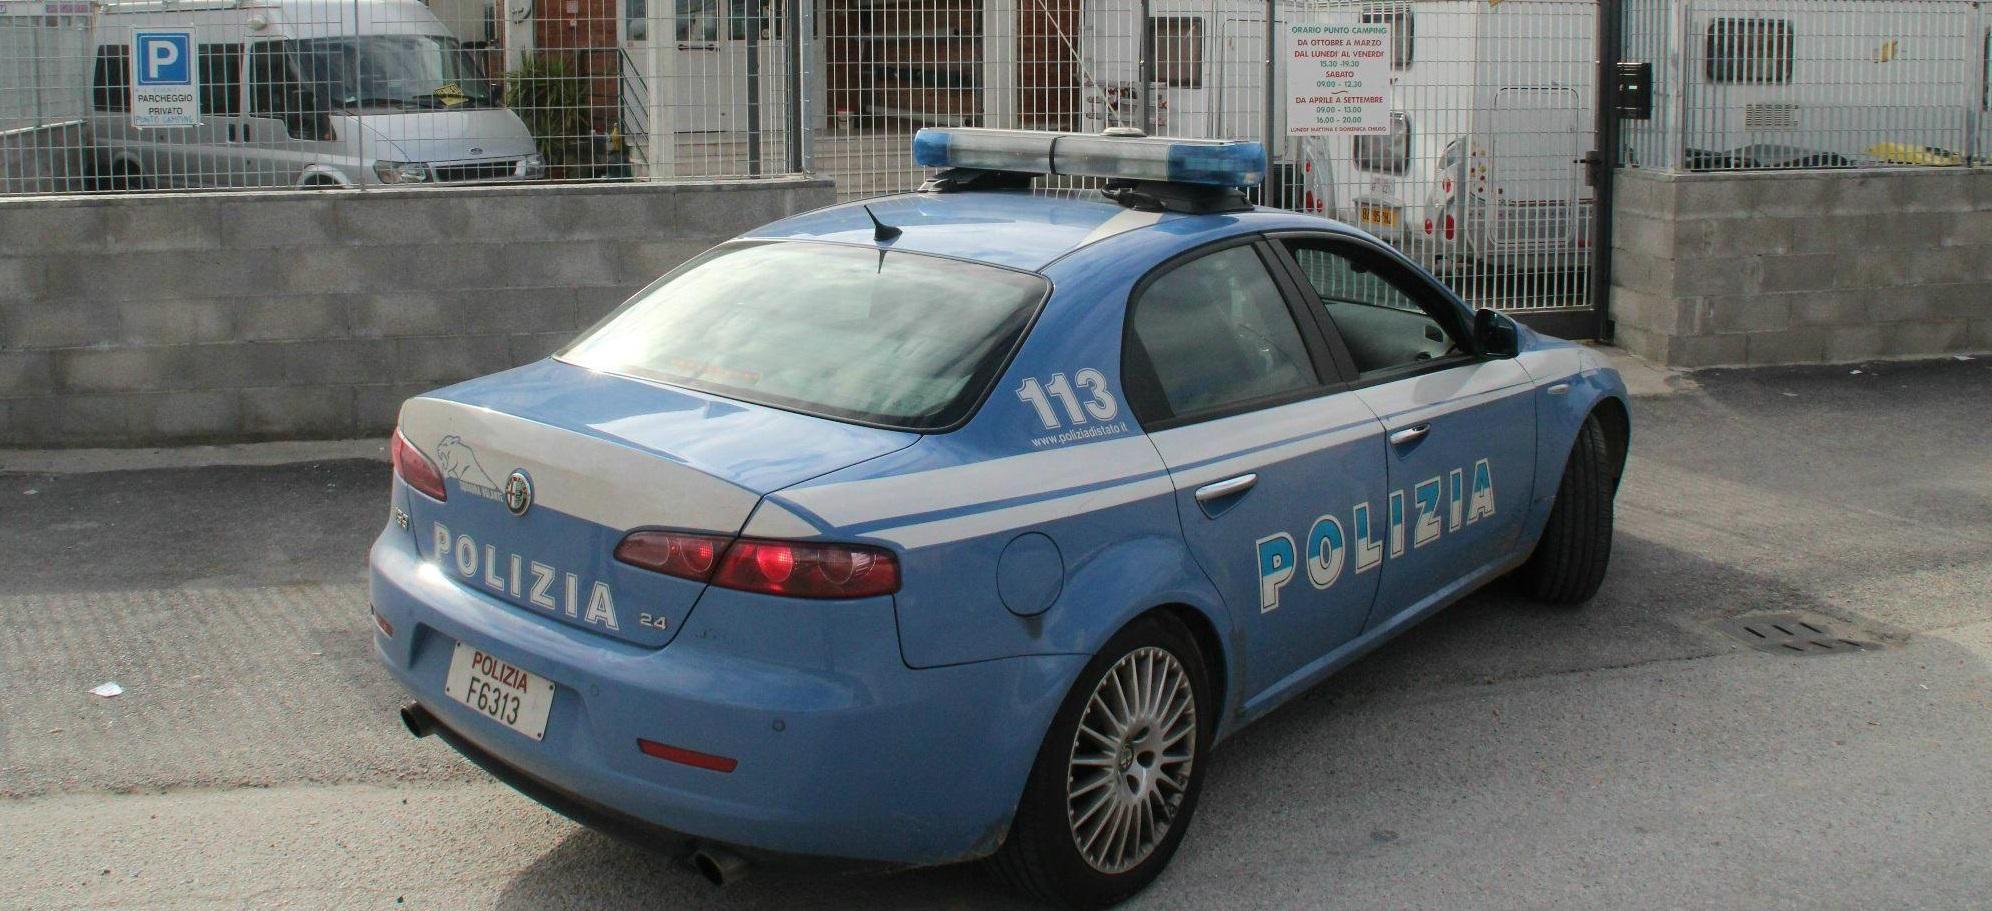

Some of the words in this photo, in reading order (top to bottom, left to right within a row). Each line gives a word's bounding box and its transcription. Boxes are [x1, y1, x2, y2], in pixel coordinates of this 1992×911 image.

[1292, 26, 1321, 34] ORARIO
[1324, 26, 1349, 34] PUNTO
[1352, 26, 1387, 34] CAMPING
[1298, 39, 1308, 47] DA
[1311, 39, 1343, 47] OTTOBRE
[1345, 39, 1352, 47] A
[1354, 39, 1382, 47] MARZO
[1294, 50, 1309, 58] DAL
[1341, 50, 1350, 58] AL
[148, 40, 179, 79] P
[1316, 80, 1336, 88] 09.00
[1344, 80, 1362, 88] 12.30
[138, 94, 193, 103] PARCHEGGIO
[1295, 96, 1306, 104] DA
[1308, 96, 1333, 104] APRILE
[1335, 96, 1342, 104] A
[1343, 96, 1384, 104] SETTEMBRE
[148, 107, 183, 116] PRIVATO
[1016, 368, 1118, 430] 113
[1256, 458, 1495, 614] POLIZIA
[434, 522, 619, 631] POLIZIA
[471, 650, 529, 694] POLIZIA
[466, 676, 520, 725] F6313
